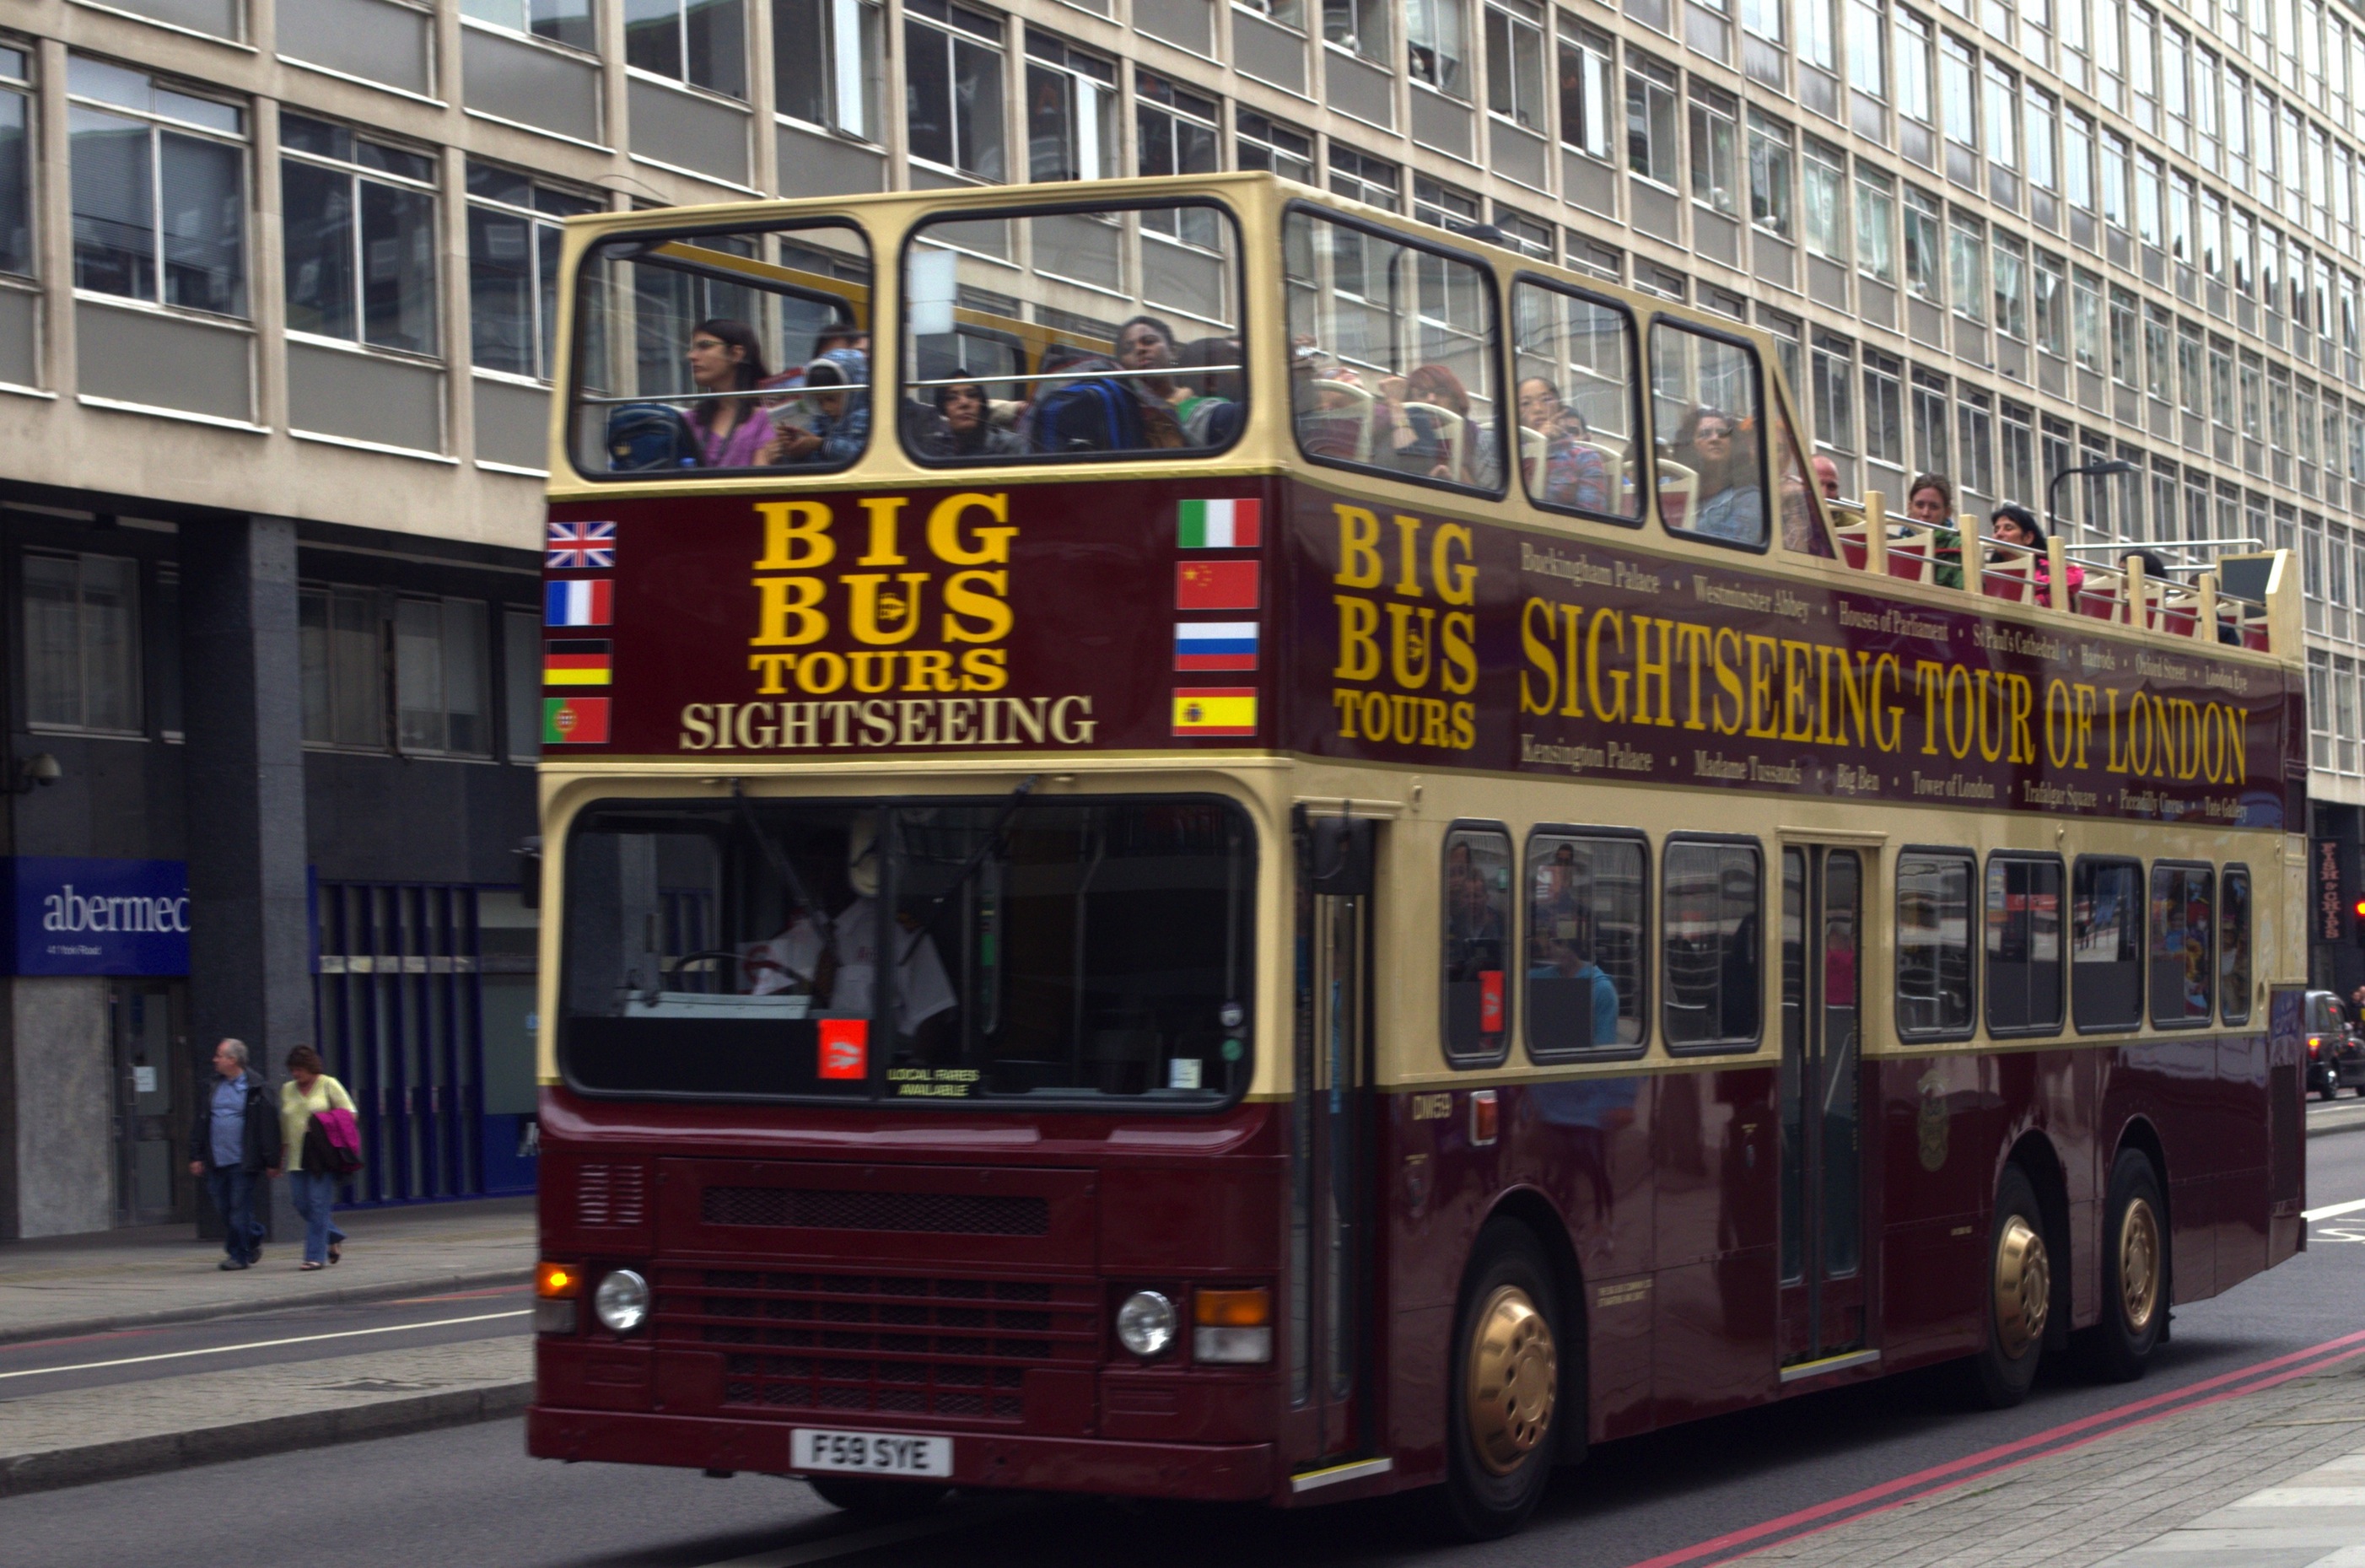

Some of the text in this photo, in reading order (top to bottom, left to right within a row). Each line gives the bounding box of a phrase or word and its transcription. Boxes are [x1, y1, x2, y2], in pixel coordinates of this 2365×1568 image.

[752, 493, 1020, 570] BIG
[1333, 504, 1479, 607] BIG
[1521, 542, 1661, 594] Buckingham Palace
[749, 568, 1015, 647] BUS
[1693, 574, 1809, 624] Westminster Abbey
[1840, 601, 1948, 642] Houses of Parliament
[1333, 595, 1479, 696] BUS
[2014, 631, 2060, 660] Cathedral
[2081, 644, 2115, 671] Harrods
[749, 649, 1009, 695] TOURS
[2136, 653, 2187, 682] Oxford Street
[2206, 665, 2248, 694] London Eye
[1522, 597, 2249, 784] SIGHTSEEING TOUR OF LONDON
[679, 694, 1098, 750] SIGHTSEEING
[1333, 687, 1476, 751] TOURS
[1521, 734, 1653, 773] Kensington Palace
[1694, 750, 1802, 785] Madame Tussauds
[1837, 763, 1880, 795] Big Ben
[1911, 770, 1995, 800] Tower of London
[2023, 779, 2097, 811] Trafalgar Square
[2120, 788, 2185, 816] Piccadilly Circus
[2205, 795, 2248, 823] Tate Gallery
[2321, 842, 2340, 880] FISH
[2321, 892, 2341, 939] CHIPS
[887, 1068, 980, 1082] LOCAL FARES
[897, 1084, 969, 1097] AVAILABLE
[811, 1435, 931, 1469] F59 SYE
